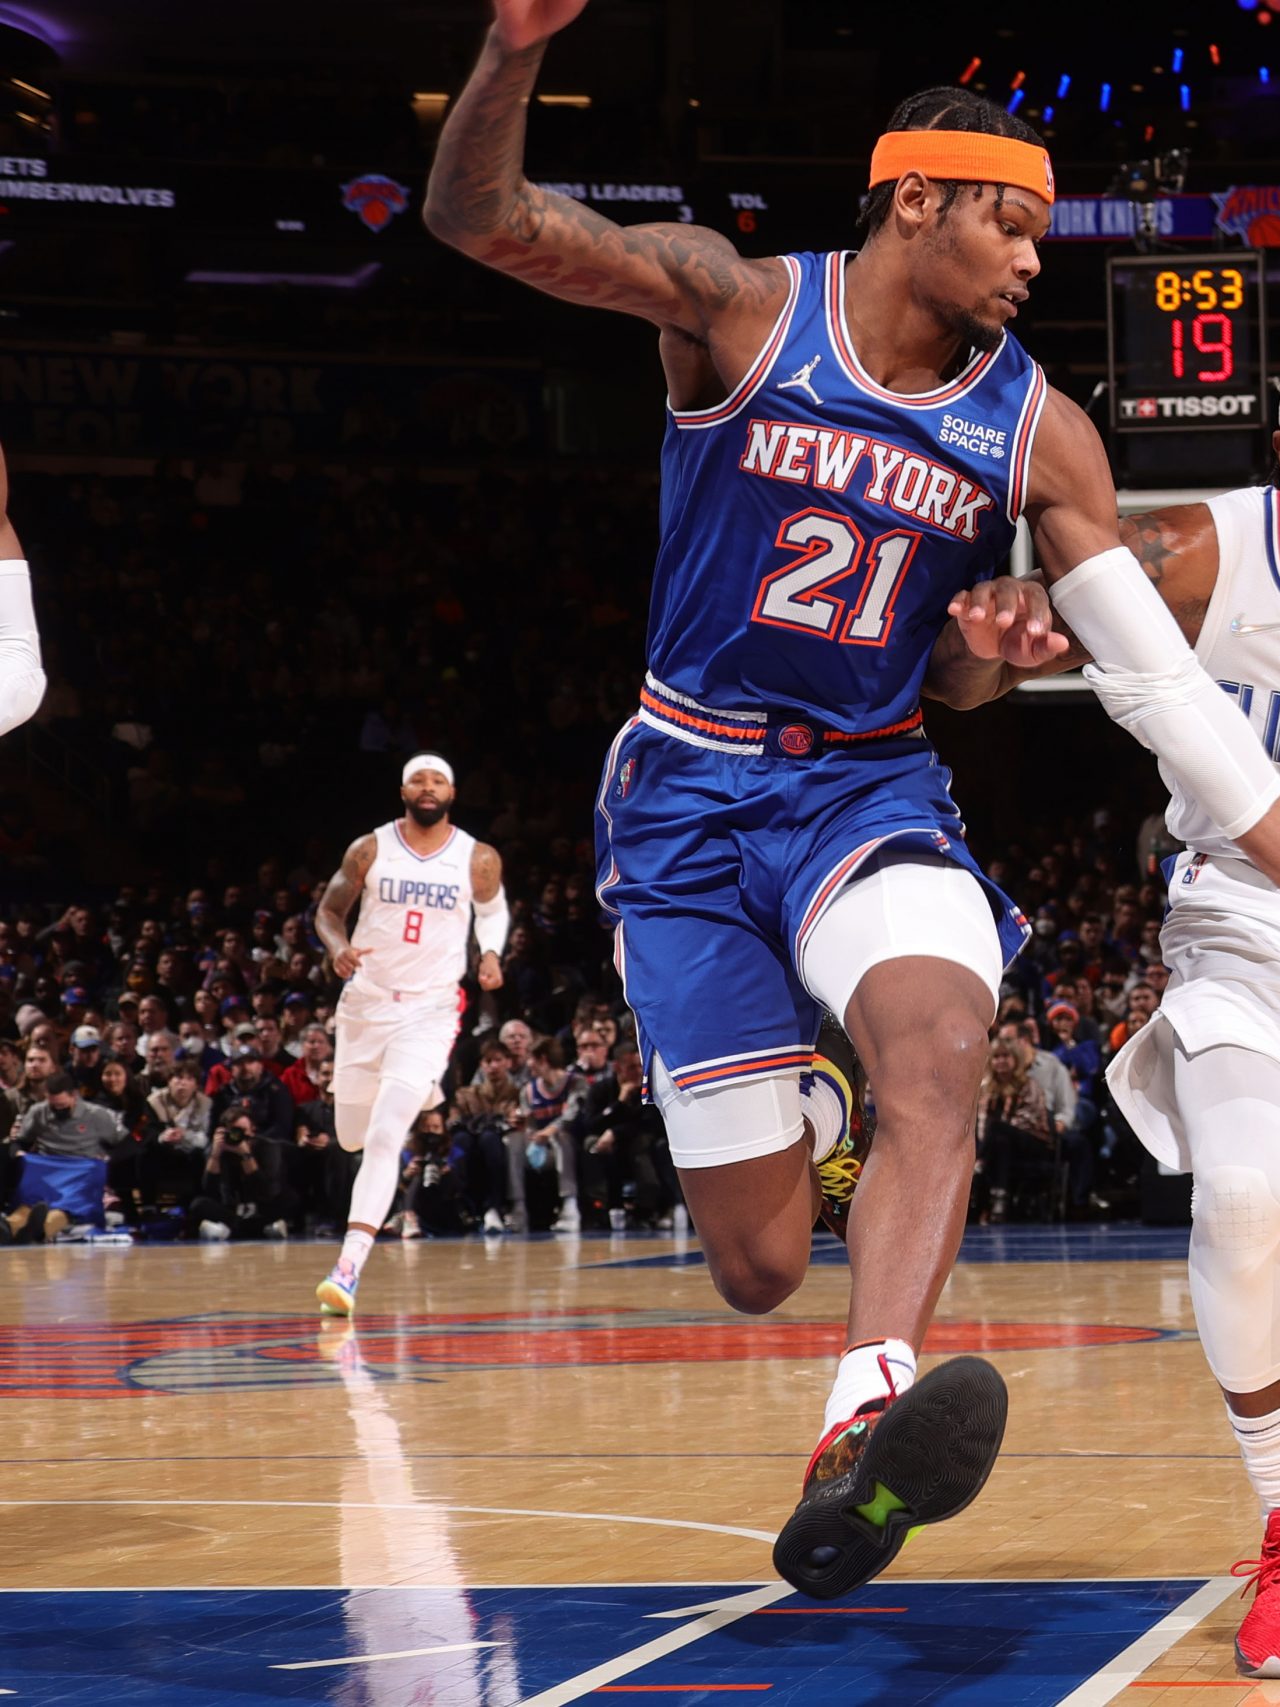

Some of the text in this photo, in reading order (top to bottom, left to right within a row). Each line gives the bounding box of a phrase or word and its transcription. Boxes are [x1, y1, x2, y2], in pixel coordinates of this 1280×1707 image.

[0, 156, 48, 177] ETS
[0, 180, 175, 208] IMBERWOLVES
[590, 183, 684, 202] LEADERS
[728, 193, 768, 210] TOL
[677, 206, 694, 223] 3
[736, 210, 757, 233] 6
[1155, 268, 1245, 312] 8:53
[1171, 312, 1235, 384] 19
[1157, 395, 1257, 418] TISSOT
[938, 430, 989, 456] SPACE
[942, 414, 1007, 445] SQUARE
[739, 419, 996, 543] NEW YORK
[751, 506, 923, 647] 21
[379, 877, 460, 910] CLIPPERS
[402, 910, 423, 944] 8
